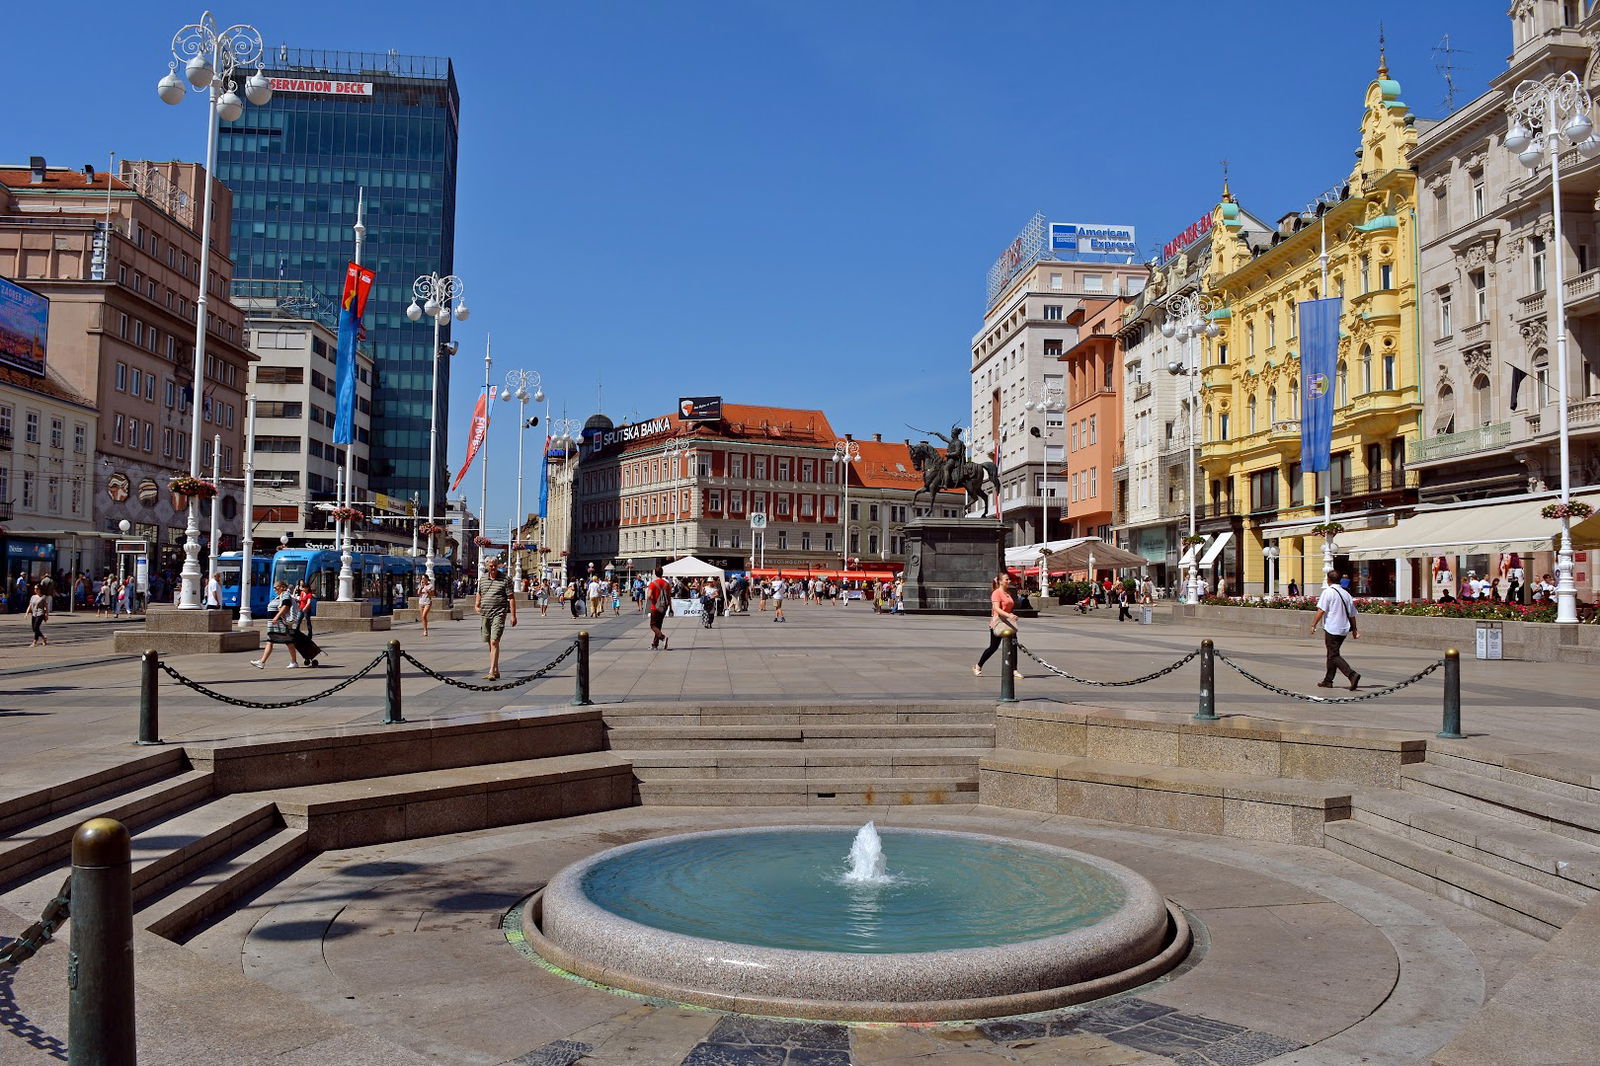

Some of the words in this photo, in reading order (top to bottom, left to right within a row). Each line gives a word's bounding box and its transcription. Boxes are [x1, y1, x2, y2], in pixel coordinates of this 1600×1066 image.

[269, 79, 331, 92] SERVATION
[336, 82, 365, 94] DECK
[1079, 227, 1129, 238] American
[1091, 238, 1135, 249] Express
[603, 425, 640, 446] SPLITSKA
[641, 417, 671, 437] BANKA
